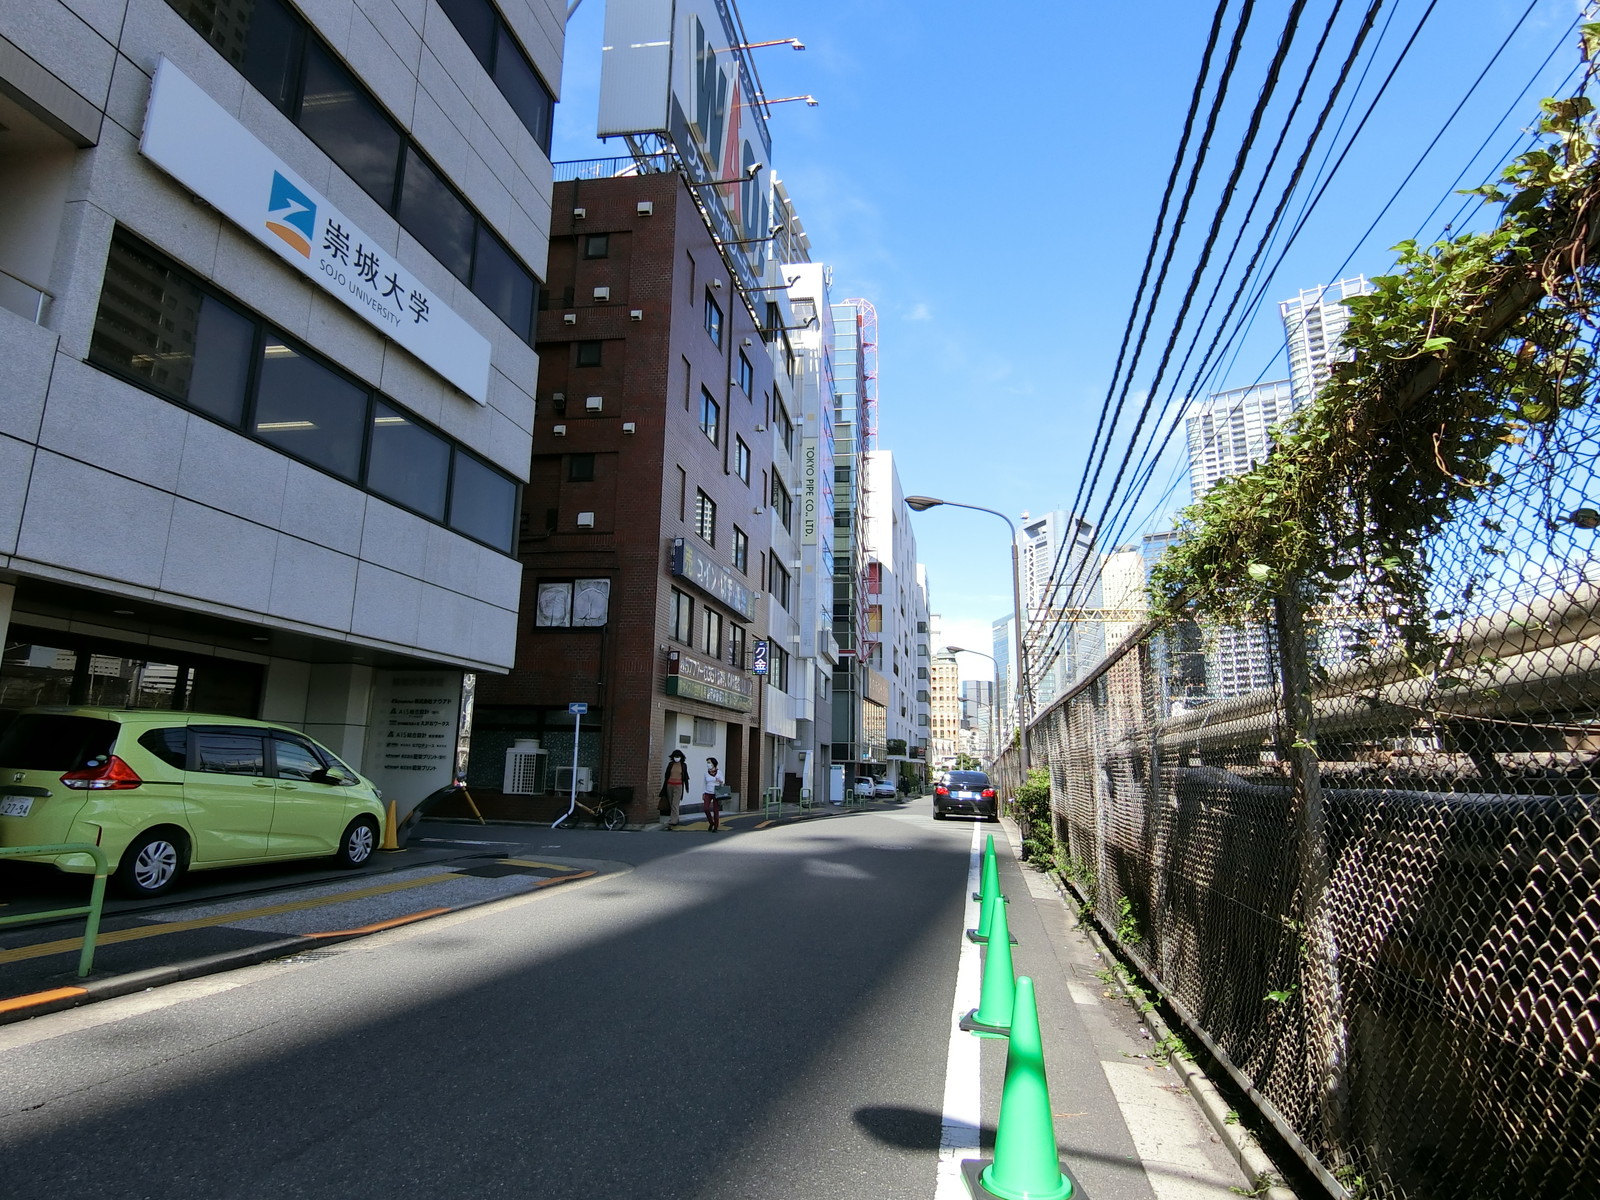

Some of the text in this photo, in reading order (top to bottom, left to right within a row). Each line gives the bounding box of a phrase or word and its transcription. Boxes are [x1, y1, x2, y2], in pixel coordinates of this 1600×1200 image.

[323, 218, 430, 324] 崇城大学
[320, 259, 401, 327] SOJO UNIVERSITY
[806, 446, 814, 475] TOKYO
[806, 480, 814, 496] PIPE
[806, 520, 814, 536] LTD.
